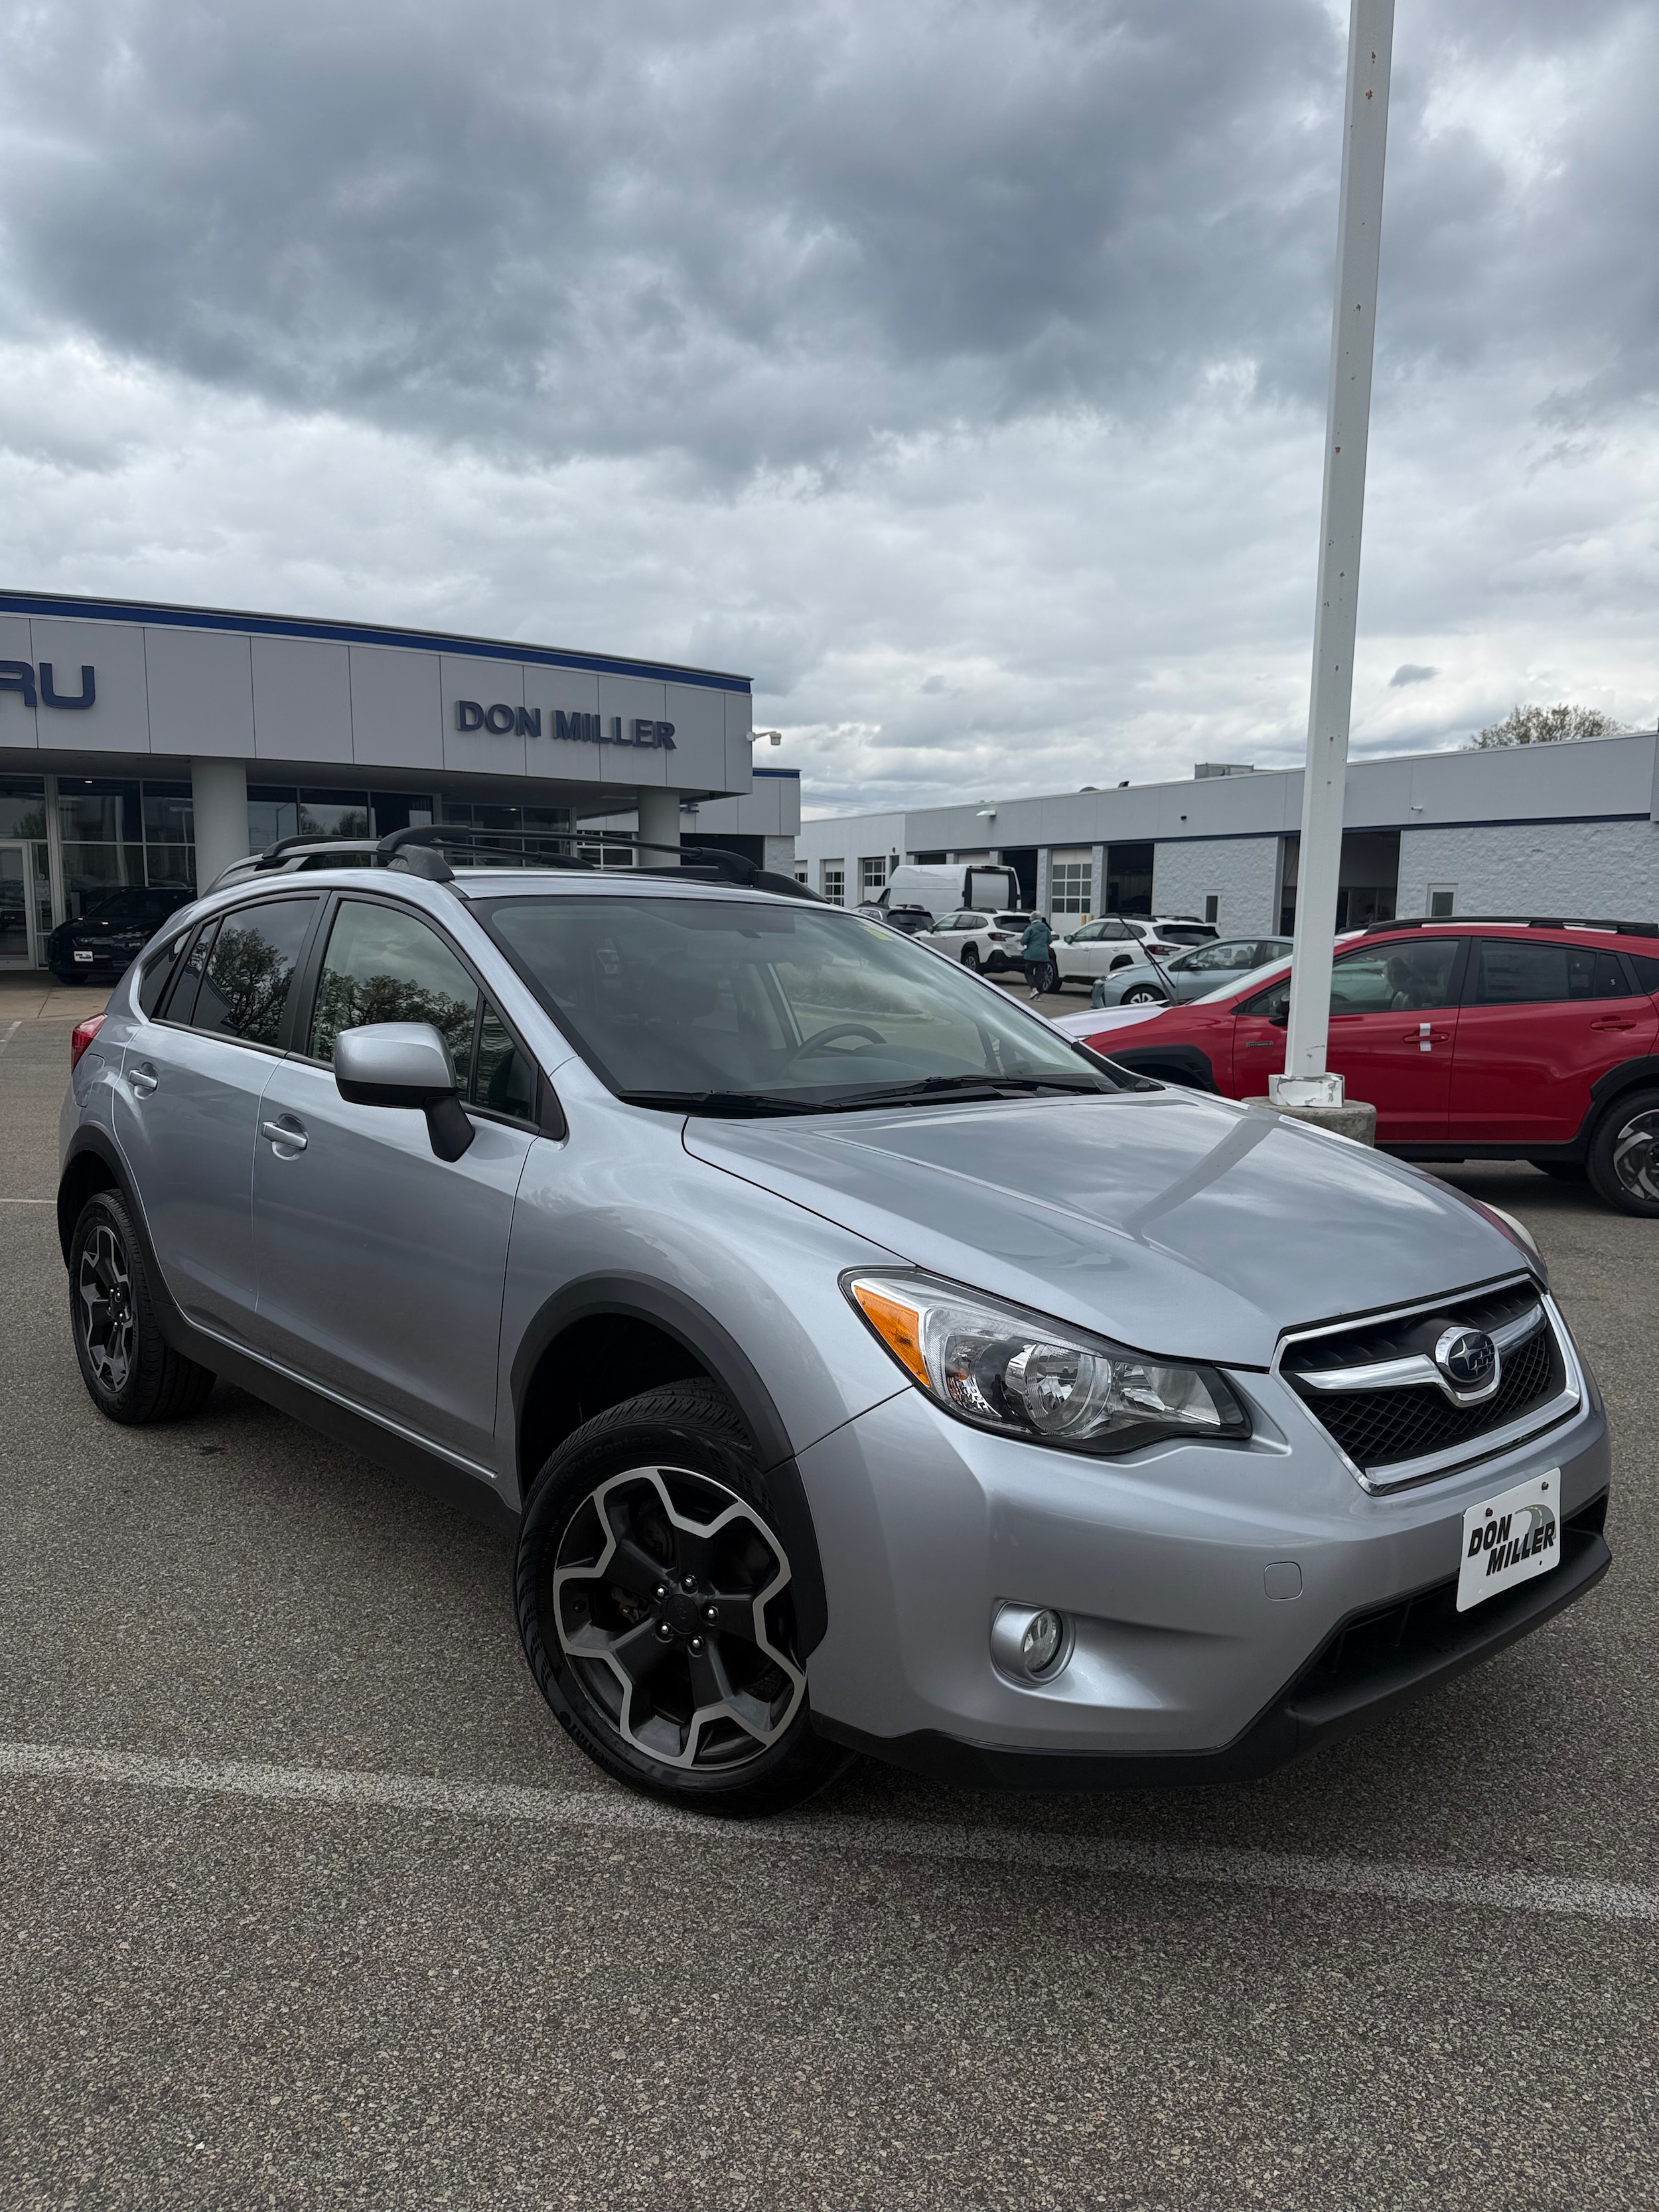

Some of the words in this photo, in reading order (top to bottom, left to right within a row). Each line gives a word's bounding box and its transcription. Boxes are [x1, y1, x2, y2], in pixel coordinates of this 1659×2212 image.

[456, 700, 541, 738] DON
[553, 710, 677, 750] MILLER
[1467, 1513, 1512, 1558] DON
[1486, 1521, 1555, 1576] MILLER
